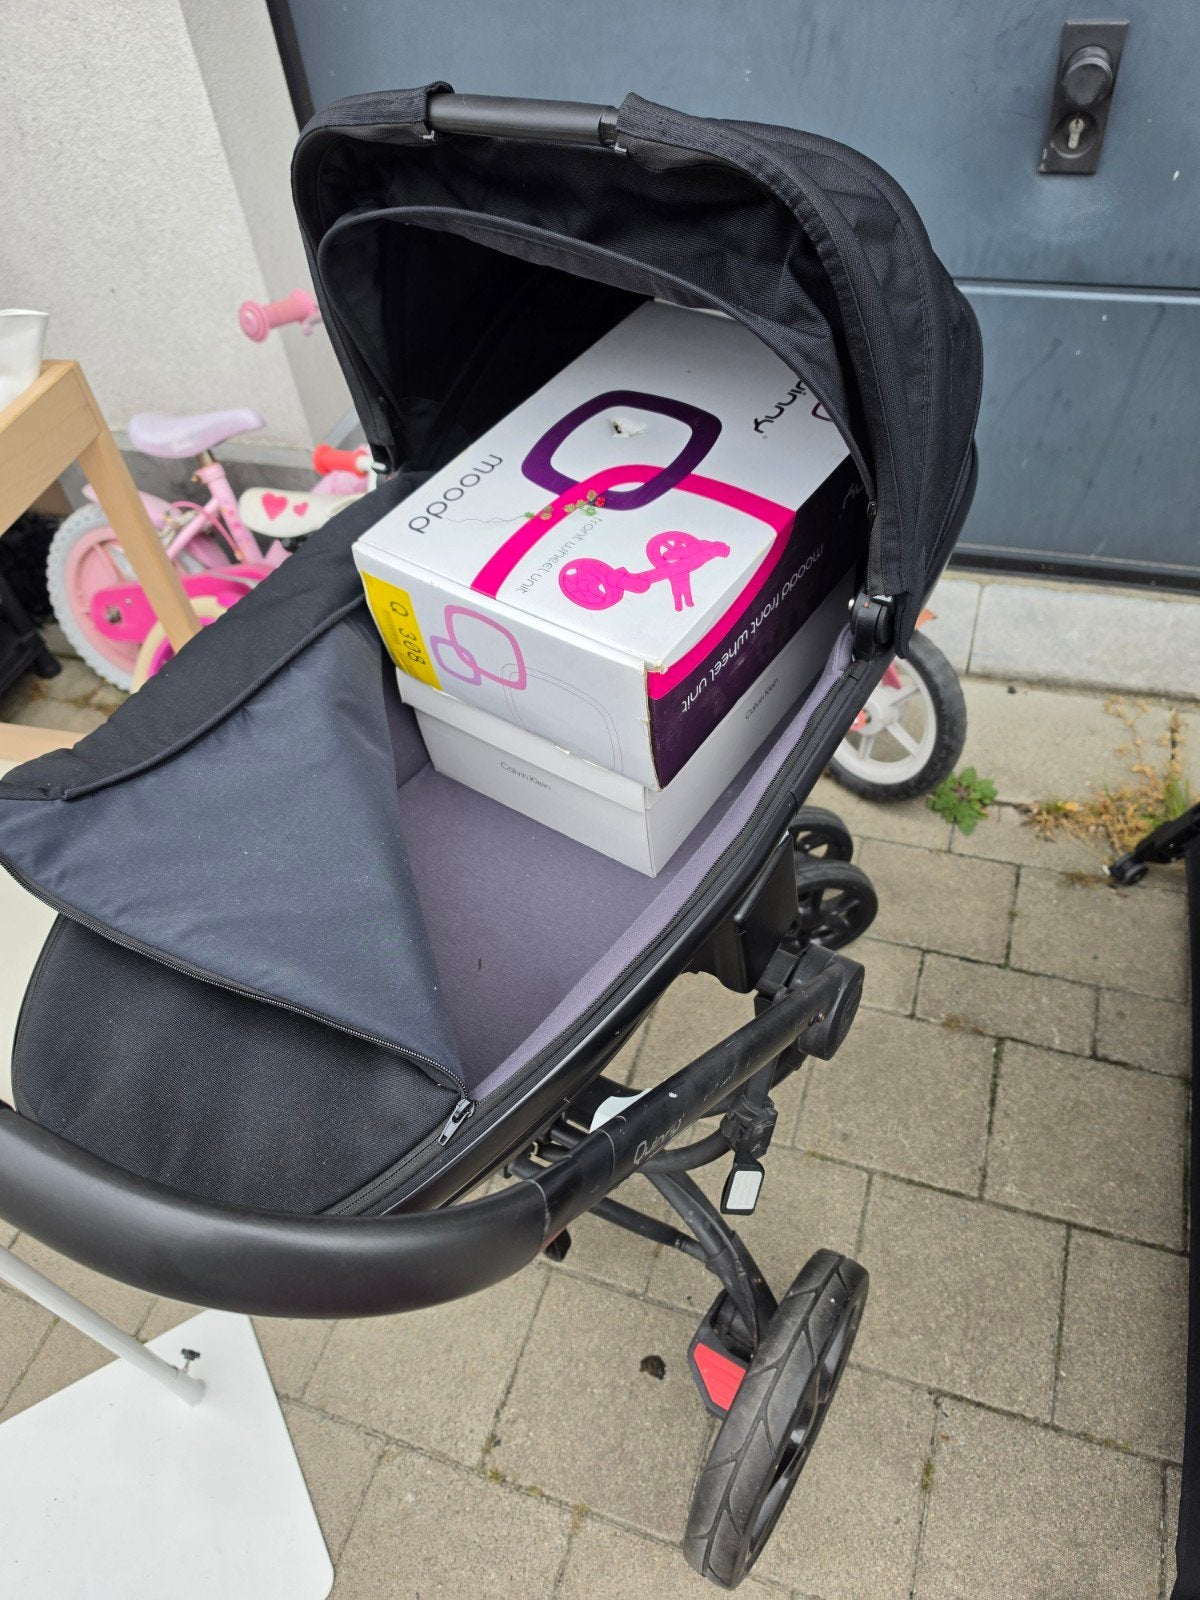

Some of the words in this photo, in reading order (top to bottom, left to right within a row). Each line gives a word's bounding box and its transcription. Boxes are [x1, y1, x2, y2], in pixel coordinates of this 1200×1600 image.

[753, 380, 807, 434] uinny
[408, 454, 503, 534] moodd
[572, 517, 603, 541] front
[538, 541, 575, 572] wheel
[781, 543, 824, 600] moodd
[516, 573, 542, 594] unit
[750, 593, 780, 634] front
[710, 629, 748, 681] wheel
[681, 677, 707, 713] unit
